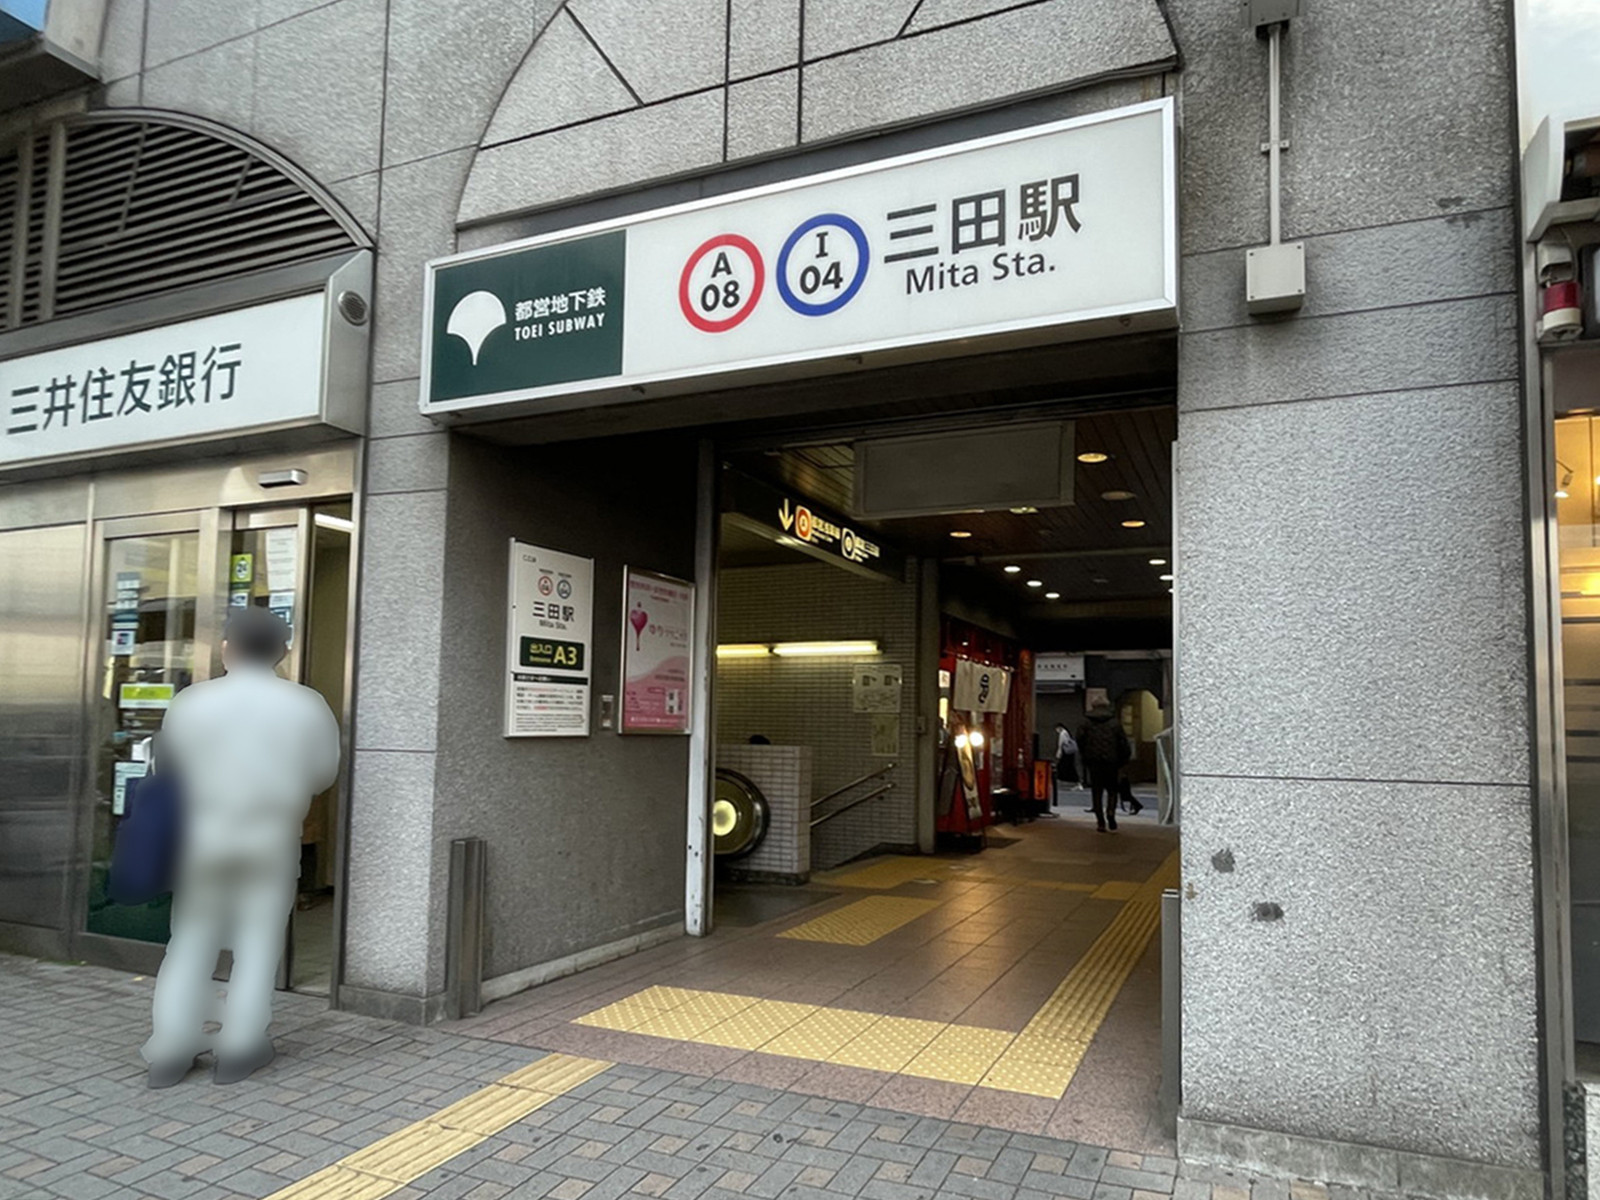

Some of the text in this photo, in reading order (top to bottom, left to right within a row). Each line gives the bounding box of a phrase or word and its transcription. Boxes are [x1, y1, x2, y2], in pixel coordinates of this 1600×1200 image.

[884, 173, 1082, 264] 三田駅
[815, 231, 829, 259] I
[711, 251, 732, 278] A
[800, 261, 843, 295] 04
[906, 252, 1056, 295] Mita Sta.
[514, 286, 607, 322] 都営地下鉄
[701, 280, 740, 312] 08
[514, 312, 606, 341] TOEI SUBWAY
[6, 342, 242, 435] 三井住友銀行
[532, 601, 575, 623] 三田駅
[553, 645, 578, 666] A3
